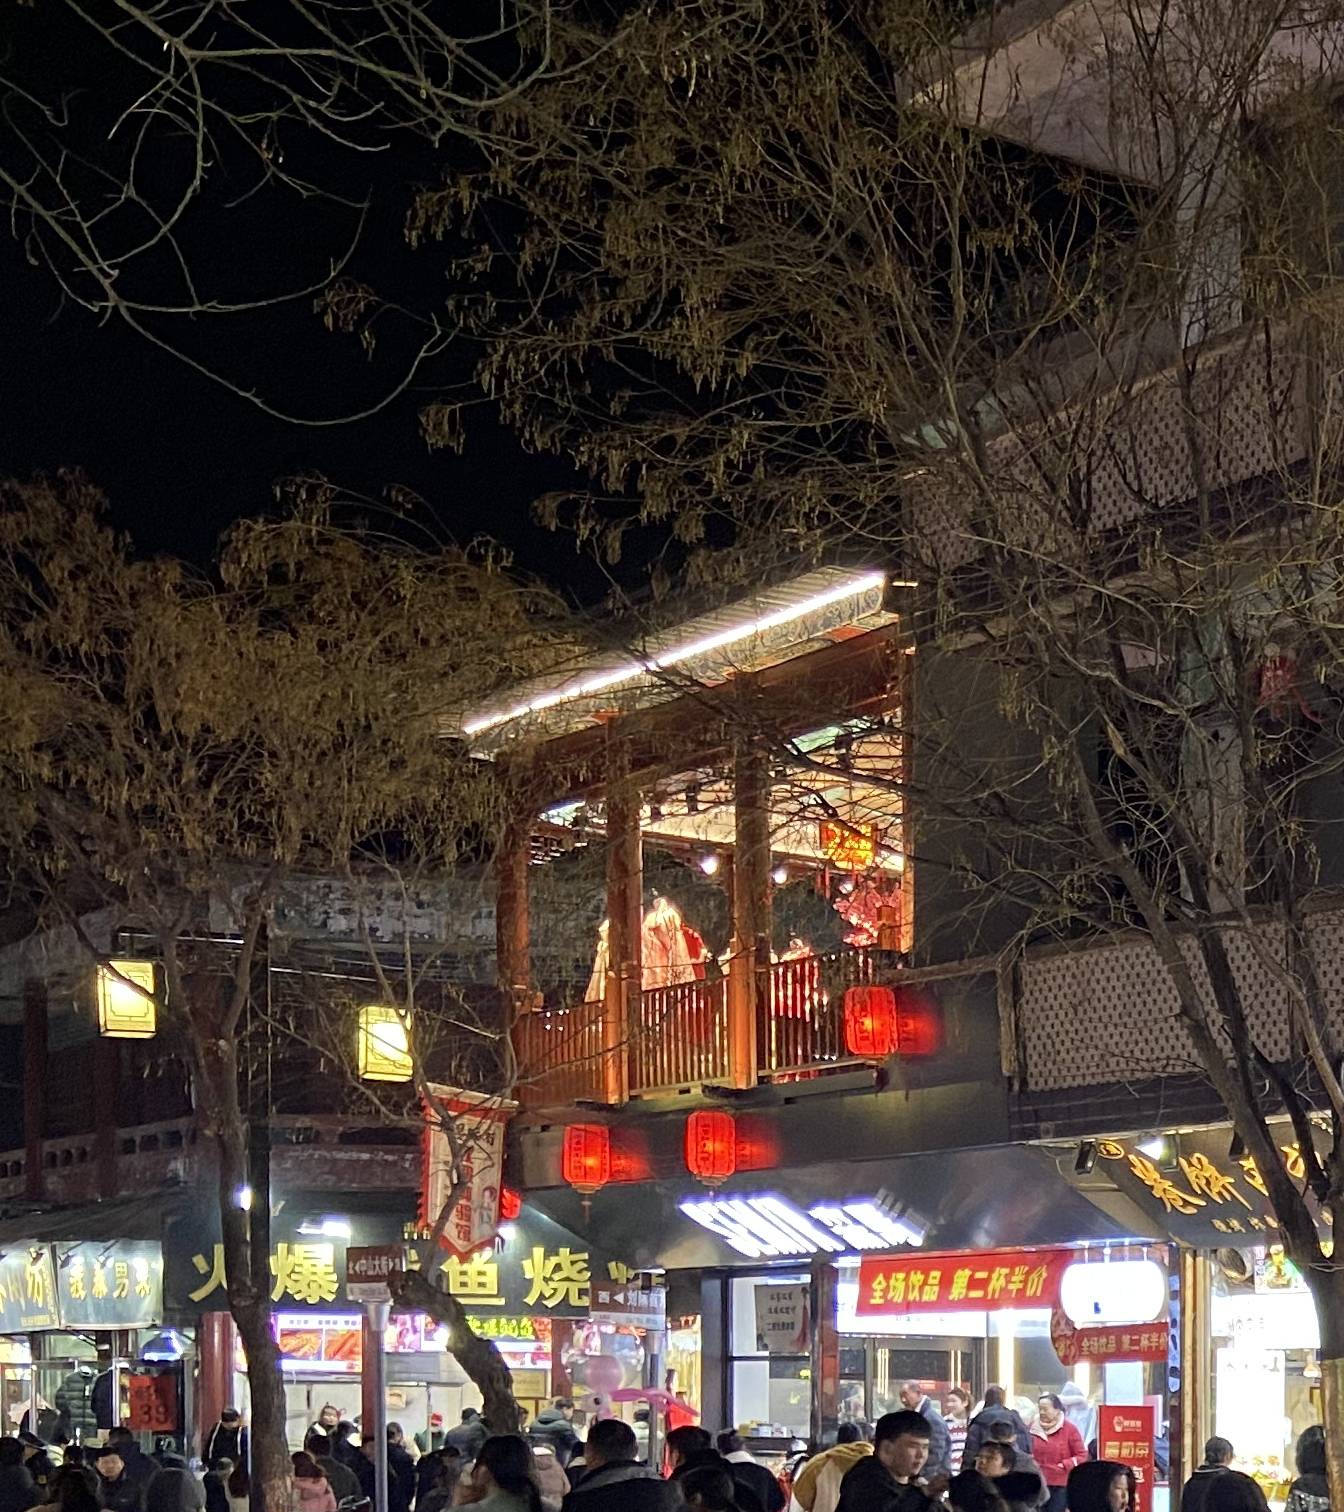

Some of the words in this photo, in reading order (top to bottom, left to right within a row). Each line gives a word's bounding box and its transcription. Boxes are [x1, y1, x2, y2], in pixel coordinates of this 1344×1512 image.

[868, 1262, 942, 1305] 全场饮品
[948, 1263, 1048, 1301] 第二杯半价
